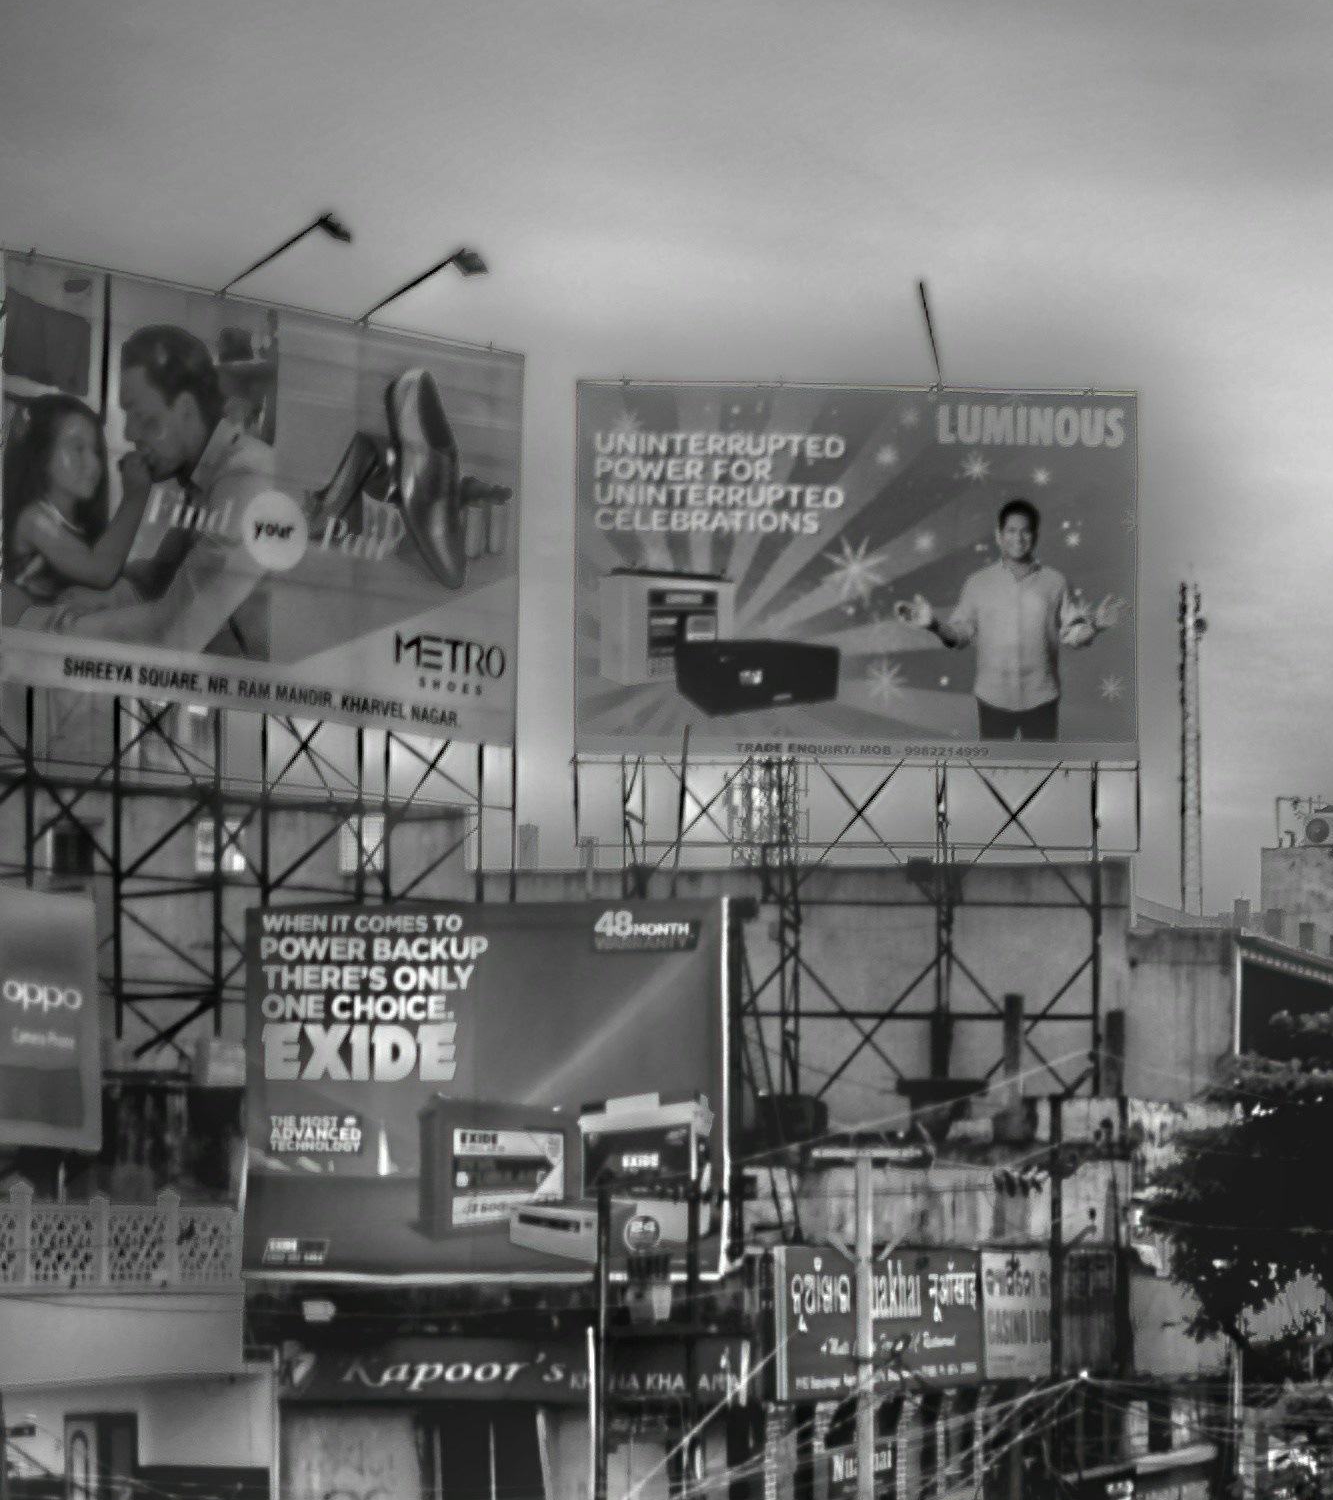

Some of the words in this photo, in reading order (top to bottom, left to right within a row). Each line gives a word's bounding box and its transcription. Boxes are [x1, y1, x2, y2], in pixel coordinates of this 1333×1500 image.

[937, 404, 1124, 449] LUMINOUS
[595, 432, 845, 459] UNINTERRUPTED
[595, 457, 704, 481] POWER
[713, 458, 772, 482] FOR
[595, 483, 845, 509] UNINTERRUPTED
[254, 520, 295, 541] your
[595, 508, 819, 534] CELEBRATIONS
[395, 631, 506, 679] METRO
[63, 656, 133, 683] SHREEYA
[138, 666, 203, 695] SQUARE,
[208, 677, 233, 696] NR.
[238, 679, 270, 700] RAM
[275, 683, 336, 712] MANDIR,
[340, 693, 406, 721] KHARVEL
[411, 705, 462, 729] NAGAR.
[418, 676, 482, 697] SHOES
[736, 742, 783, 754] TRADE
[788, 743, 853, 756] ENQUIRY:
[860, 744, 892, 757] MOB
[262, 914, 327, 932] WHEN
[331, 914, 351, 932] IT
[354, 914, 428, 932] COMES
[433, 914, 463, 932] TO
[260, 936, 366, 961] POWER
[372, 935, 489, 962] BACKUP
[262, 964, 387, 991] THERE'S
[393, 964, 475, 991] ONLY
[3, 980, 83, 1013] oppo
[261, 994, 325, 1020] ONE
[331, 994, 455, 1020] CHOICE.
[261, 1022, 457, 1082] EXIDE
[270, 1115, 297, 1128] THE
[300, 1115, 338, 1128] MOST
[270, 1126, 362, 1141] ADVANCED
[270, 1140, 361, 1152] TECHNOLOGY
[460, 1131, 499, 1146] EXIDE
[622, 1152, 660, 1170] EXIDE
[871, 1259, 921, 1319] uakhai
[342, 1352, 566, 1392] Kapoor's
